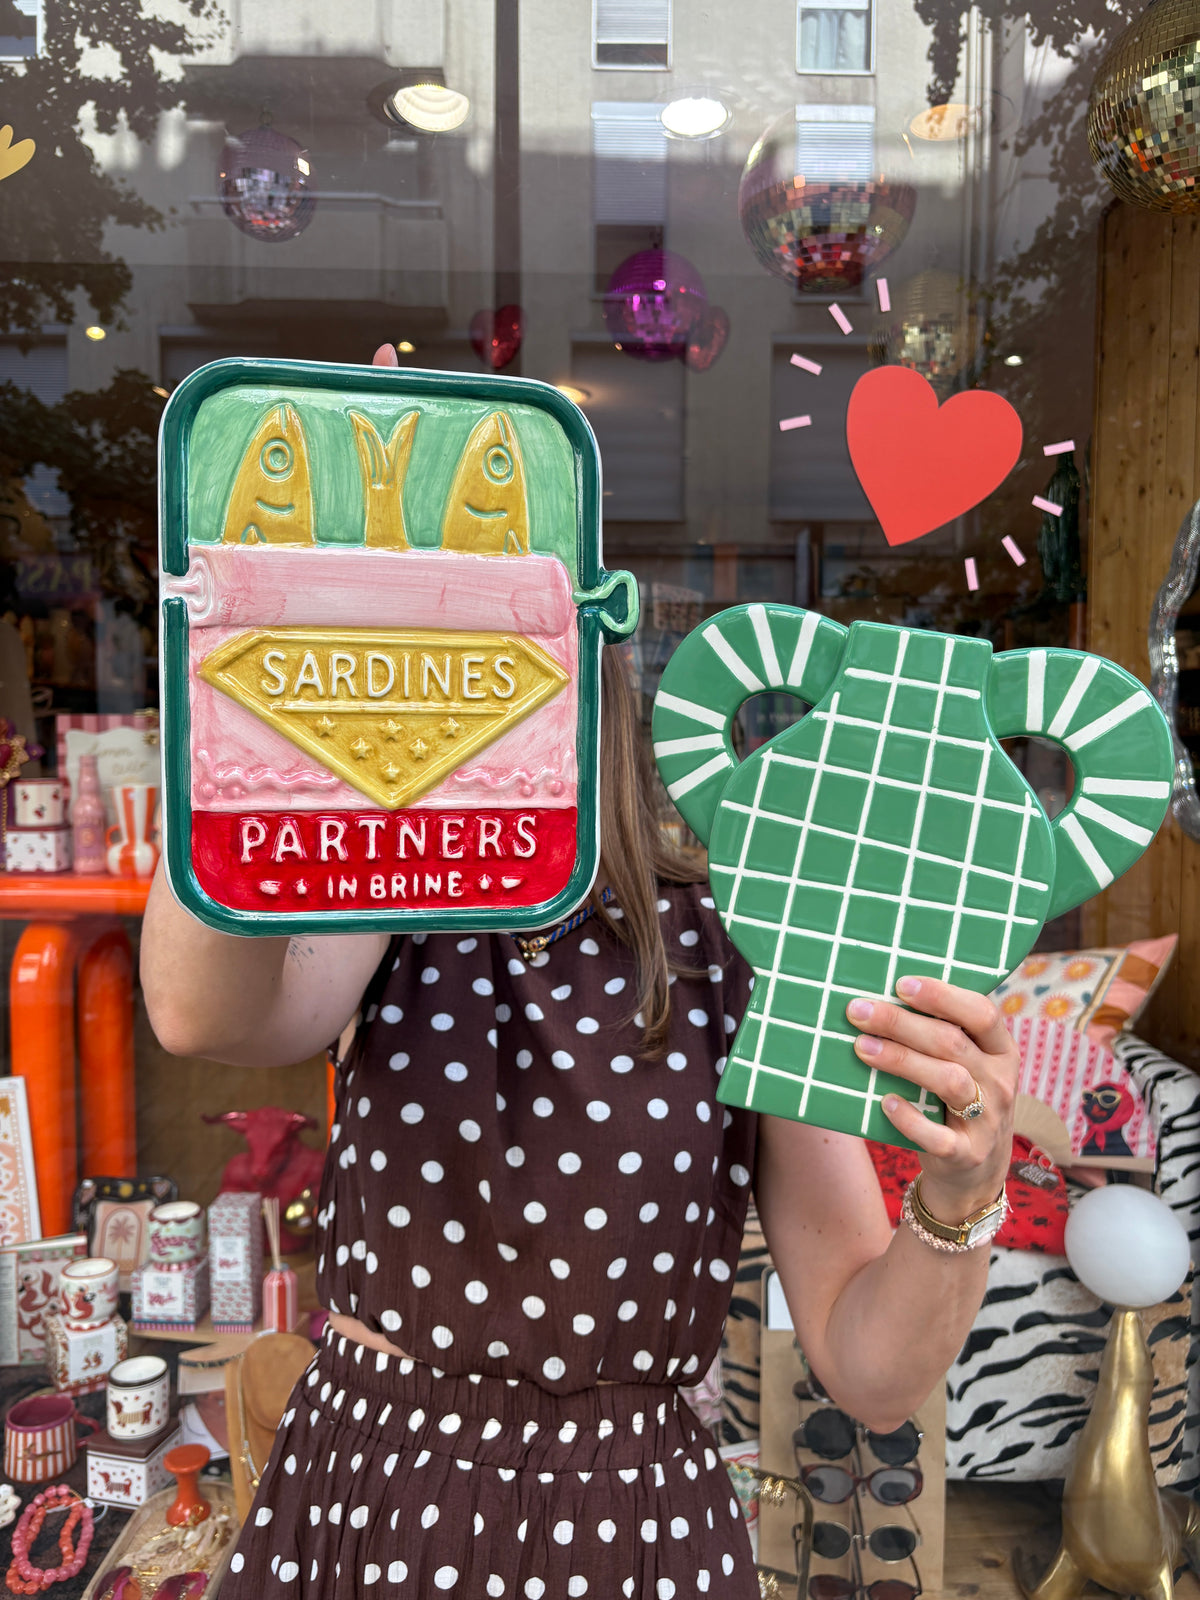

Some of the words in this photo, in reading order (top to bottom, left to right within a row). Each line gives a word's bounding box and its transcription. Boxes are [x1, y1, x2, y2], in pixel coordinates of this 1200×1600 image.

[261, 651, 516, 699] SARDINES
[239, 814, 538, 863] PARTNERS
[327, 874, 358, 900] IN
[369, 870, 464, 900] BRINE
